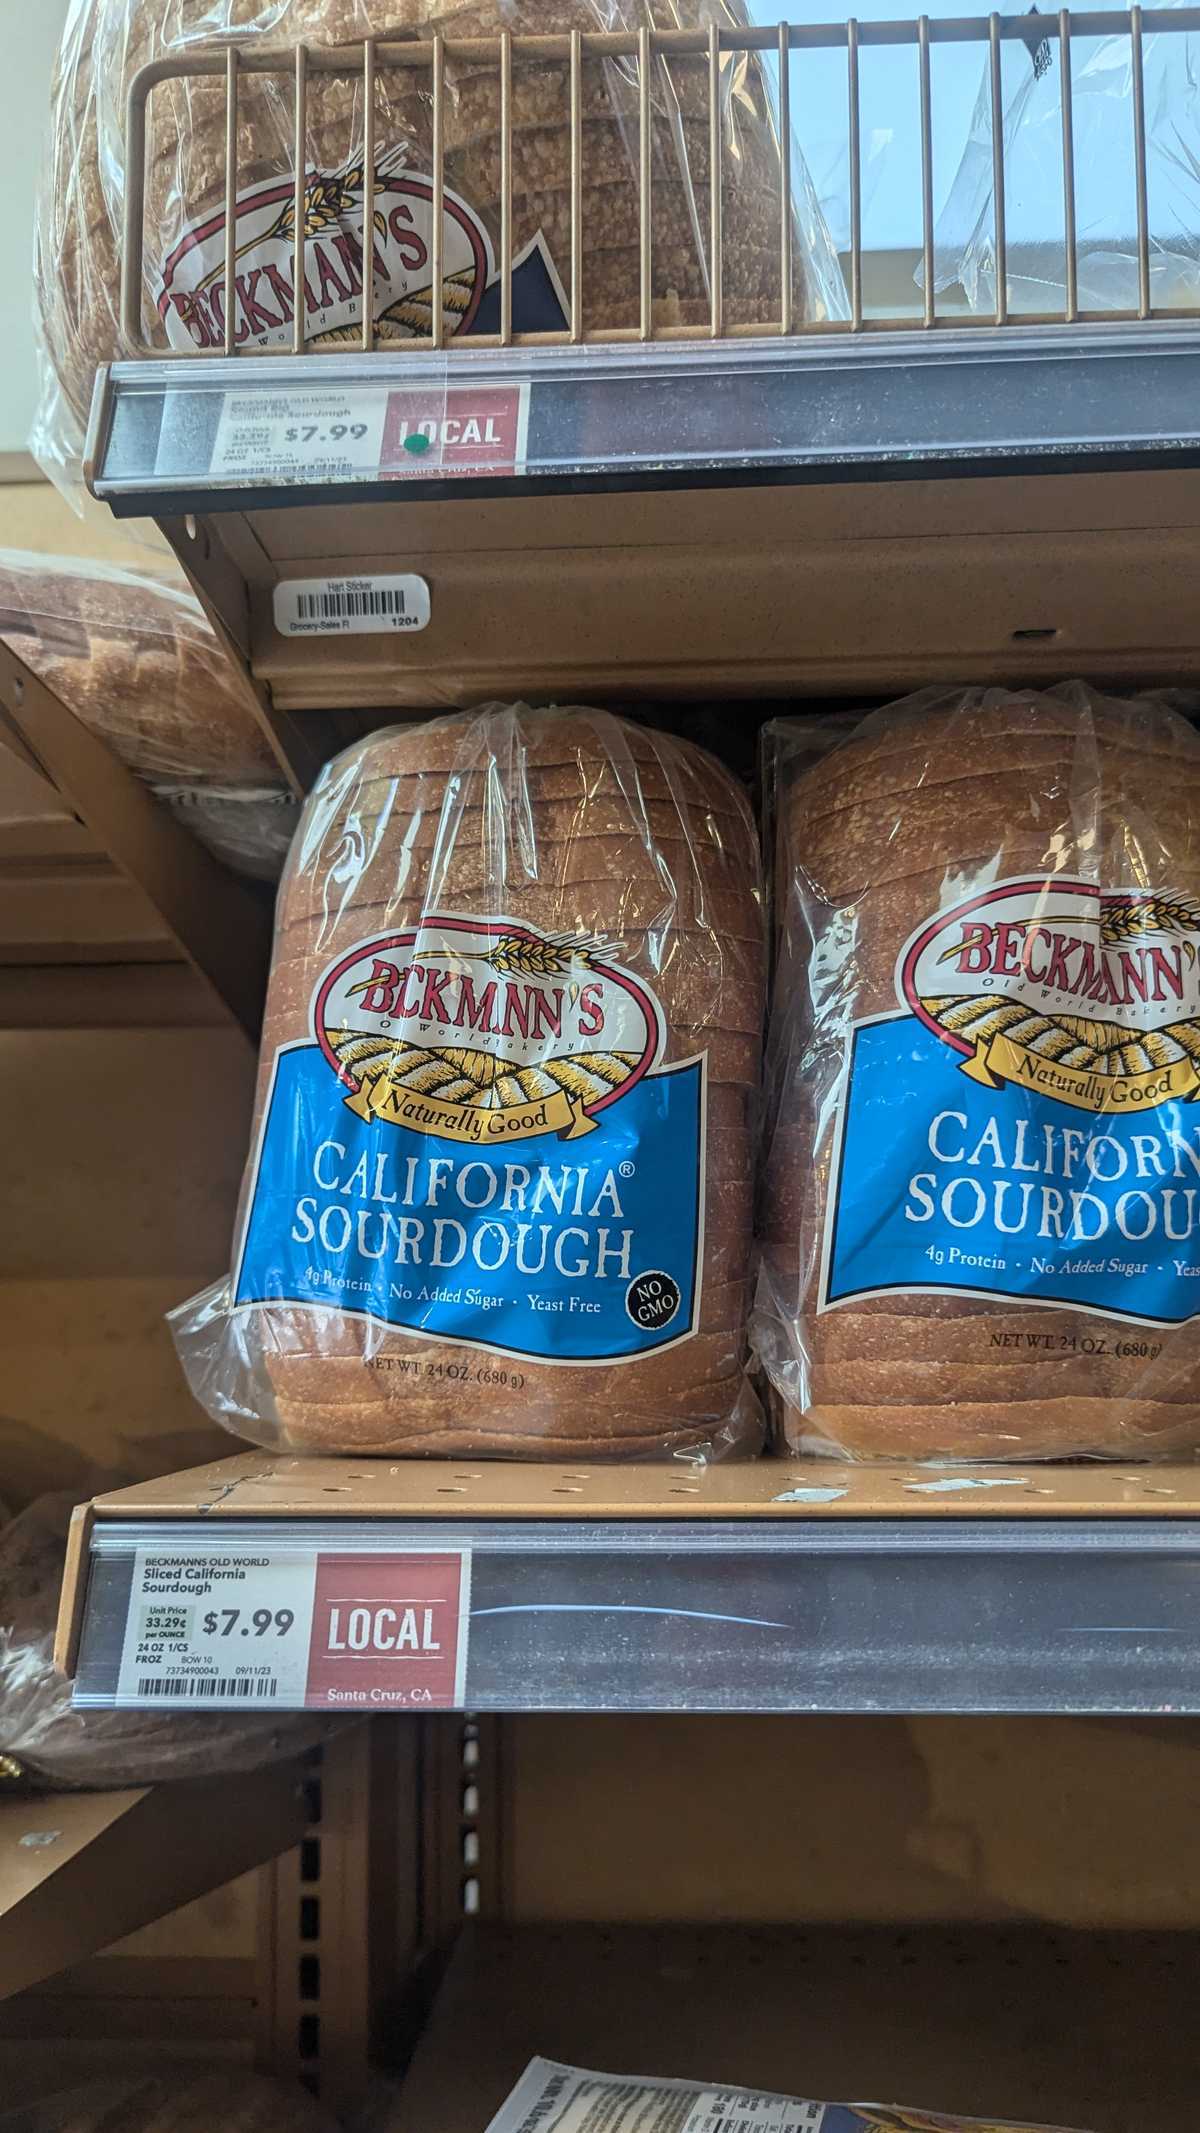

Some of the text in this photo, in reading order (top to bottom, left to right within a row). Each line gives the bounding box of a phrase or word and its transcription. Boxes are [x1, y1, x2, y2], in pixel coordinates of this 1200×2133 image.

[284, 424, 368, 442] $7.99
[399, 418, 501, 445] LOCAL
[392, 617, 419, 626] 1204
[955, 922, 1200, 1006] BECKMANN'
[1016, 1055, 1174, 1108] Naturally Good
[381, 1088, 550, 1141] Naturally Good
[905, 1174, 1200, 1241] SOURDOU
[291, 1198, 634, 1280] SOURDOUGH
[925, 1245, 943, 1265] 4g
[949, 1248, 1006, 1270] Protein
[1030, 1258, 1055, 1274] No
[1059, 1259, 1104, 1274] Added
[1107, 1258, 1148, 1278] Sugar
[323, 1269, 372, 1292] Protein
[389, 1282, 412, 1300] No
[417, 1286, 461, 1304] Added
[464, 1287, 504, 1310] Sugar
[527, 1294, 564, 1312] Yeast
[569, 1295, 601, 1314] Free
[636, 1280, 662, 1302] NO
[637, 1296, 675, 1322] GMO
[990, 1333, 1026, 1348] NET
[1060, 1336, 1078, 1350] 24
[1115, 1341, 1148, 1357] (680
[427, 1362, 446, 1378] 24
[476, 1366, 508, 1387] (680
[511, 1371, 525, 1389] g)
[144, 1568, 246, 1580] Sliced California
[145, 1558, 270, 1567] BECKMANNS OLD WORLD
[142, 1582, 212, 1596] Sourdough
[150, 1607, 187, 1615] Unit Price
[202, 1609, 294, 1637] $7.99
[145, 1631, 185, 1640] per OUNCE
[328, 1608, 440, 1651] LOCAL
[135, 1655, 213, 1664] FROZ BOW 10
[138, 1643, 189, 1653] 24 OZ 1/CS
[235, 1667, 271, 1675] 09/11/23
[327, 1688, 432, 1703] Santa Cruz, CA
